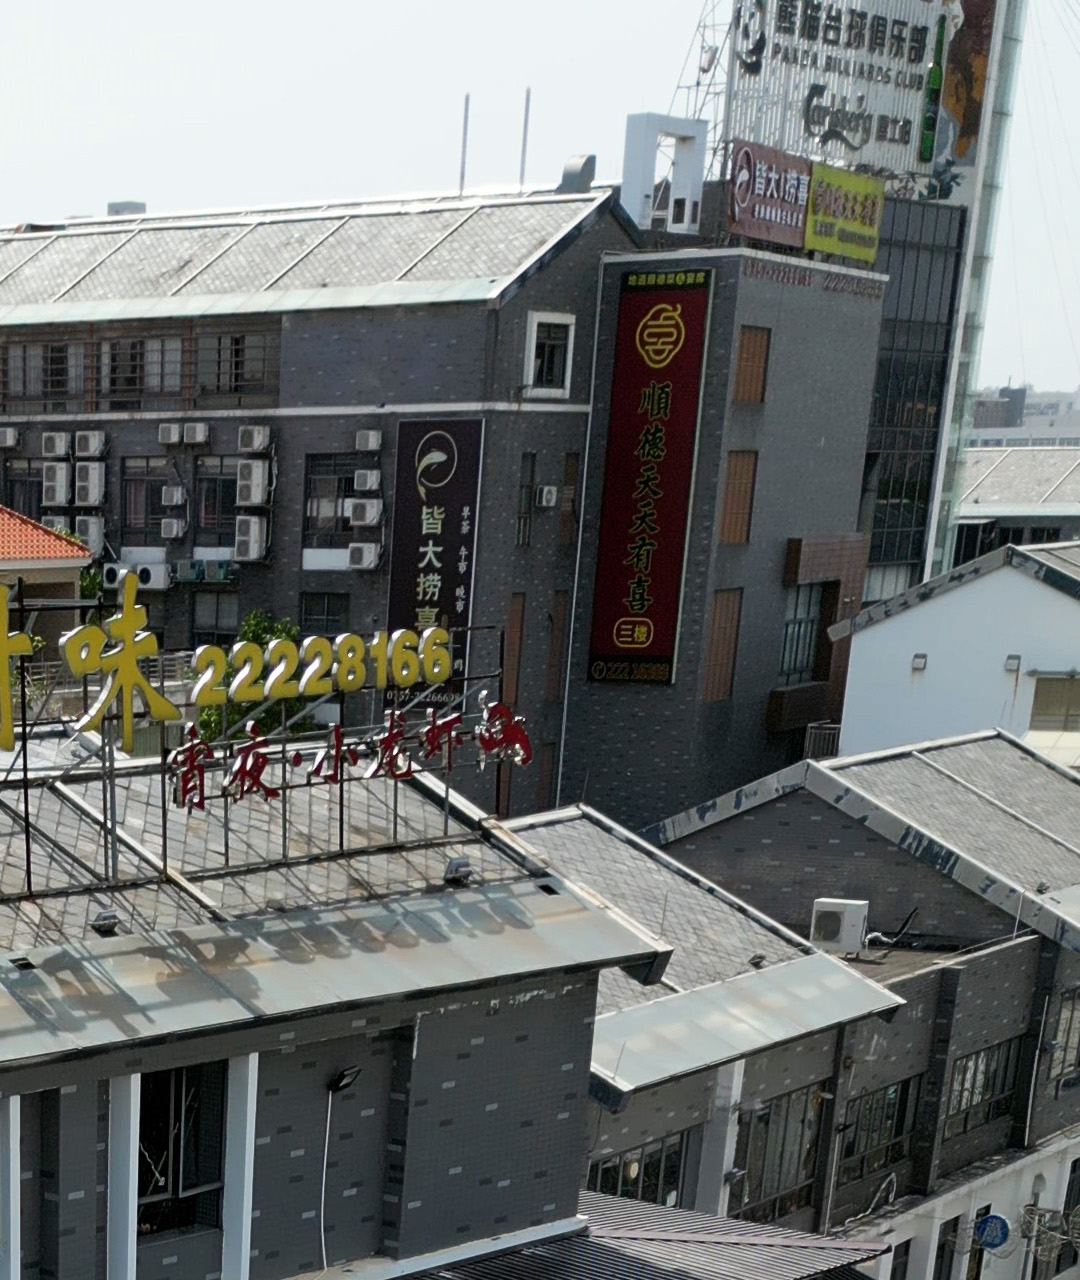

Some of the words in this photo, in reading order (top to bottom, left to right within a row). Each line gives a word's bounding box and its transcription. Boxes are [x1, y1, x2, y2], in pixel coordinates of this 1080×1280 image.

[771, 43, 818, 68] PANDA
[894, 70, 924, 91] CLUB
[190, 627, 452, 706] 22228166
